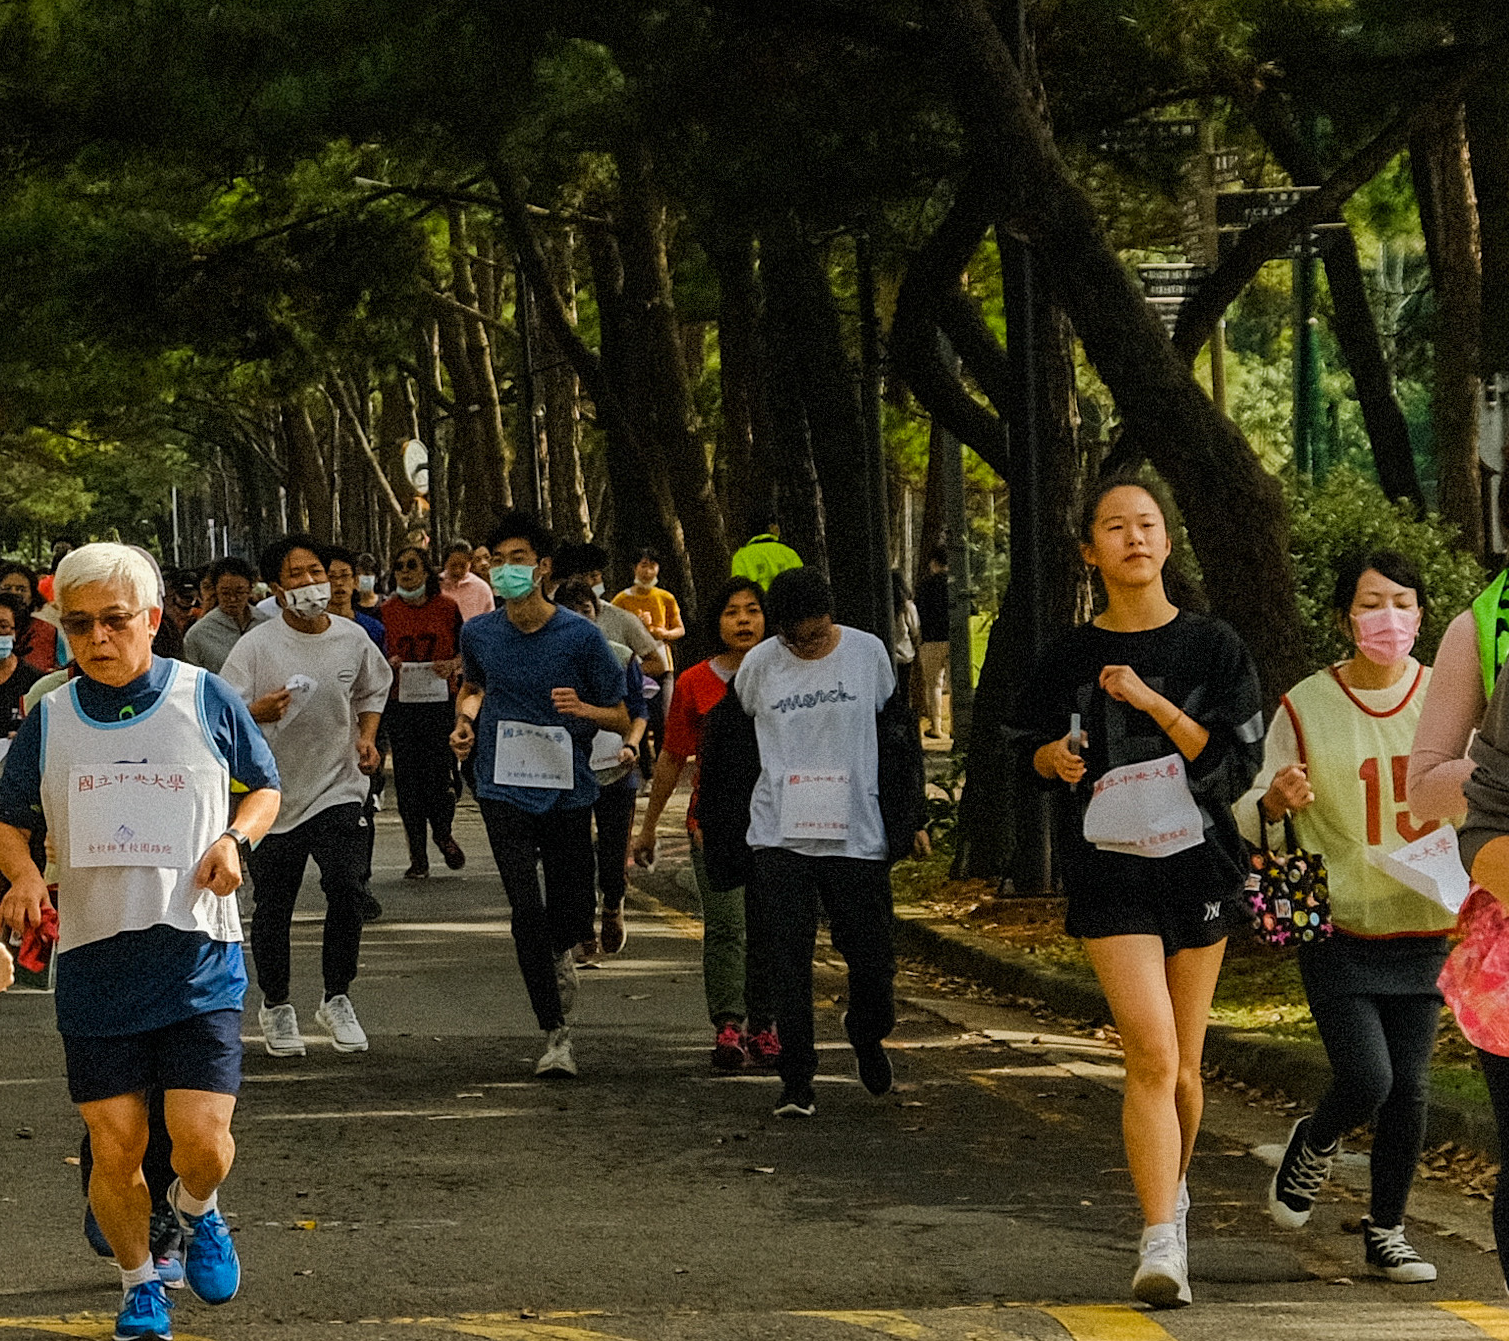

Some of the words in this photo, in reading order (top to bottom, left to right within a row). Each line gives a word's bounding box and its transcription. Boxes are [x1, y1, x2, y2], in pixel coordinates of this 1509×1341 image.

[79, 773, 185, 792] 國立中央大學
[1359, 755, 1441, 846] 15
